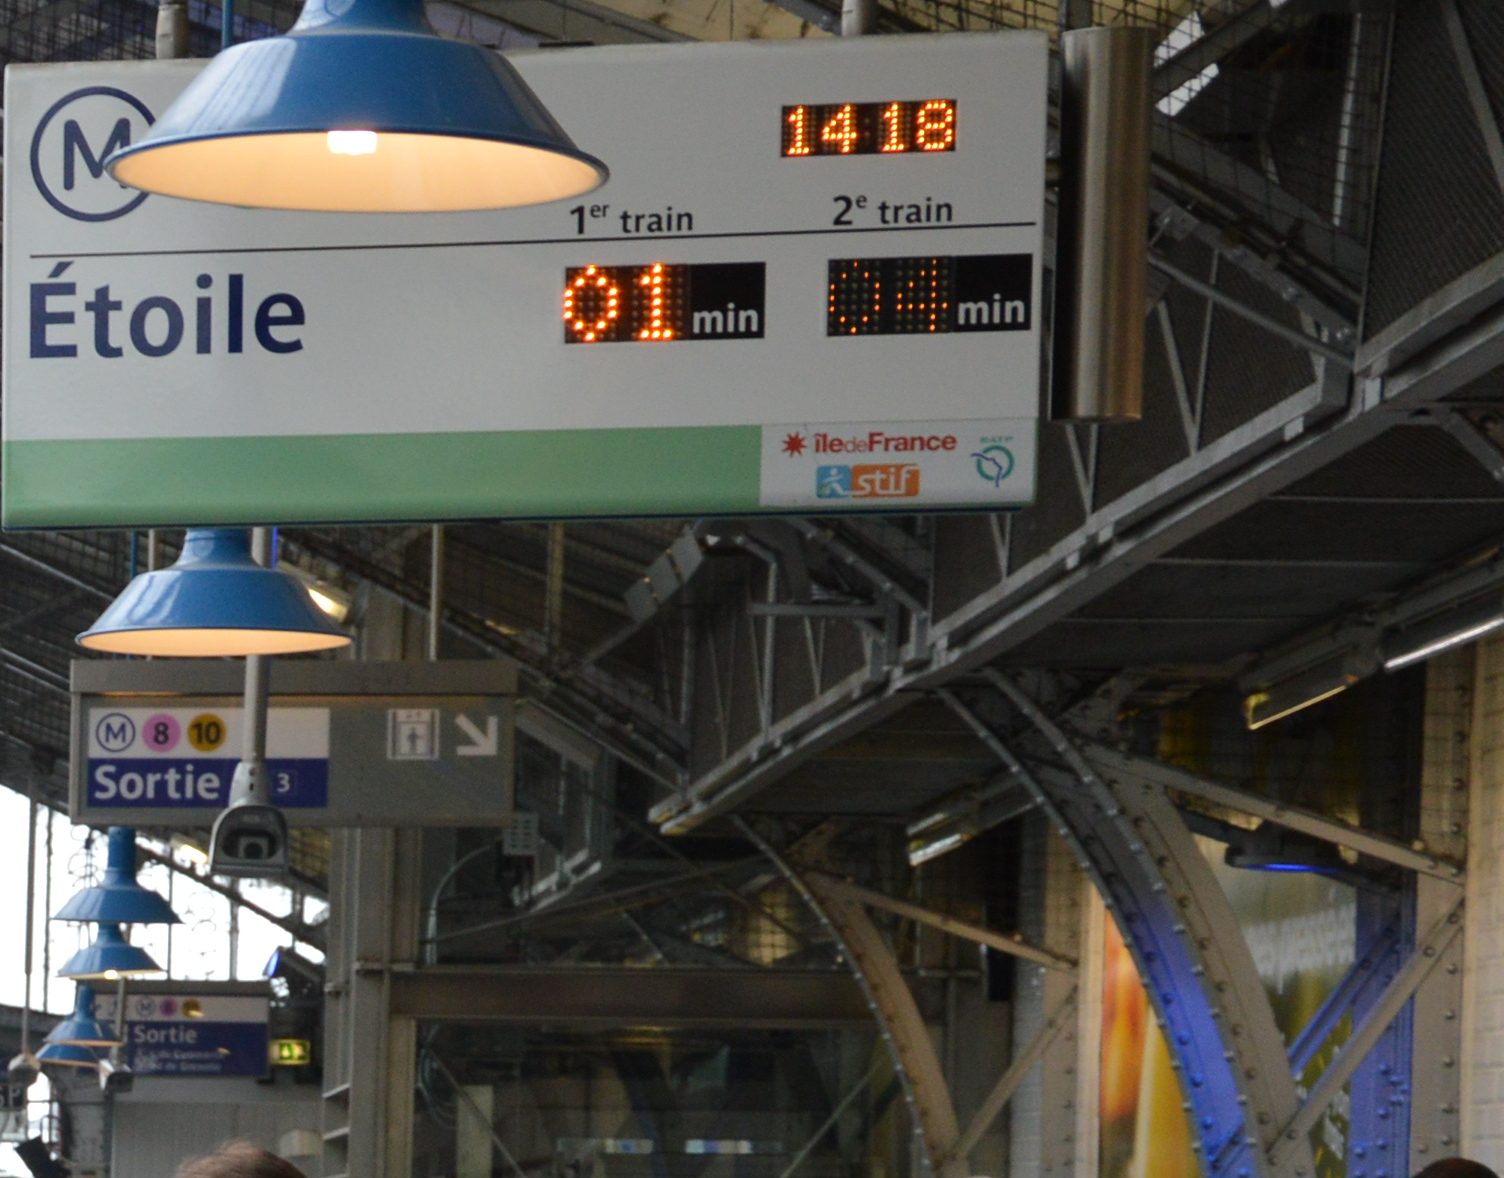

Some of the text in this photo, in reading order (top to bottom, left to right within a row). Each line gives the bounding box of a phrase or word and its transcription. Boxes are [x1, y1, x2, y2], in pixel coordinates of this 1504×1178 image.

[620, 208, 693, 234] train
[878, 199, 953, 225] train
[29, 261, 306, 359] Étoile
[563, 263, 760, 342] 01 min
[830, 259, 1026, 334] 04 min
[858, 465, 919, 496] stif
[192, 723, 222, 744] 10
[94, 765, 291, 800] Sortie 3
[134, 1023, 198, 1045] Sortie
